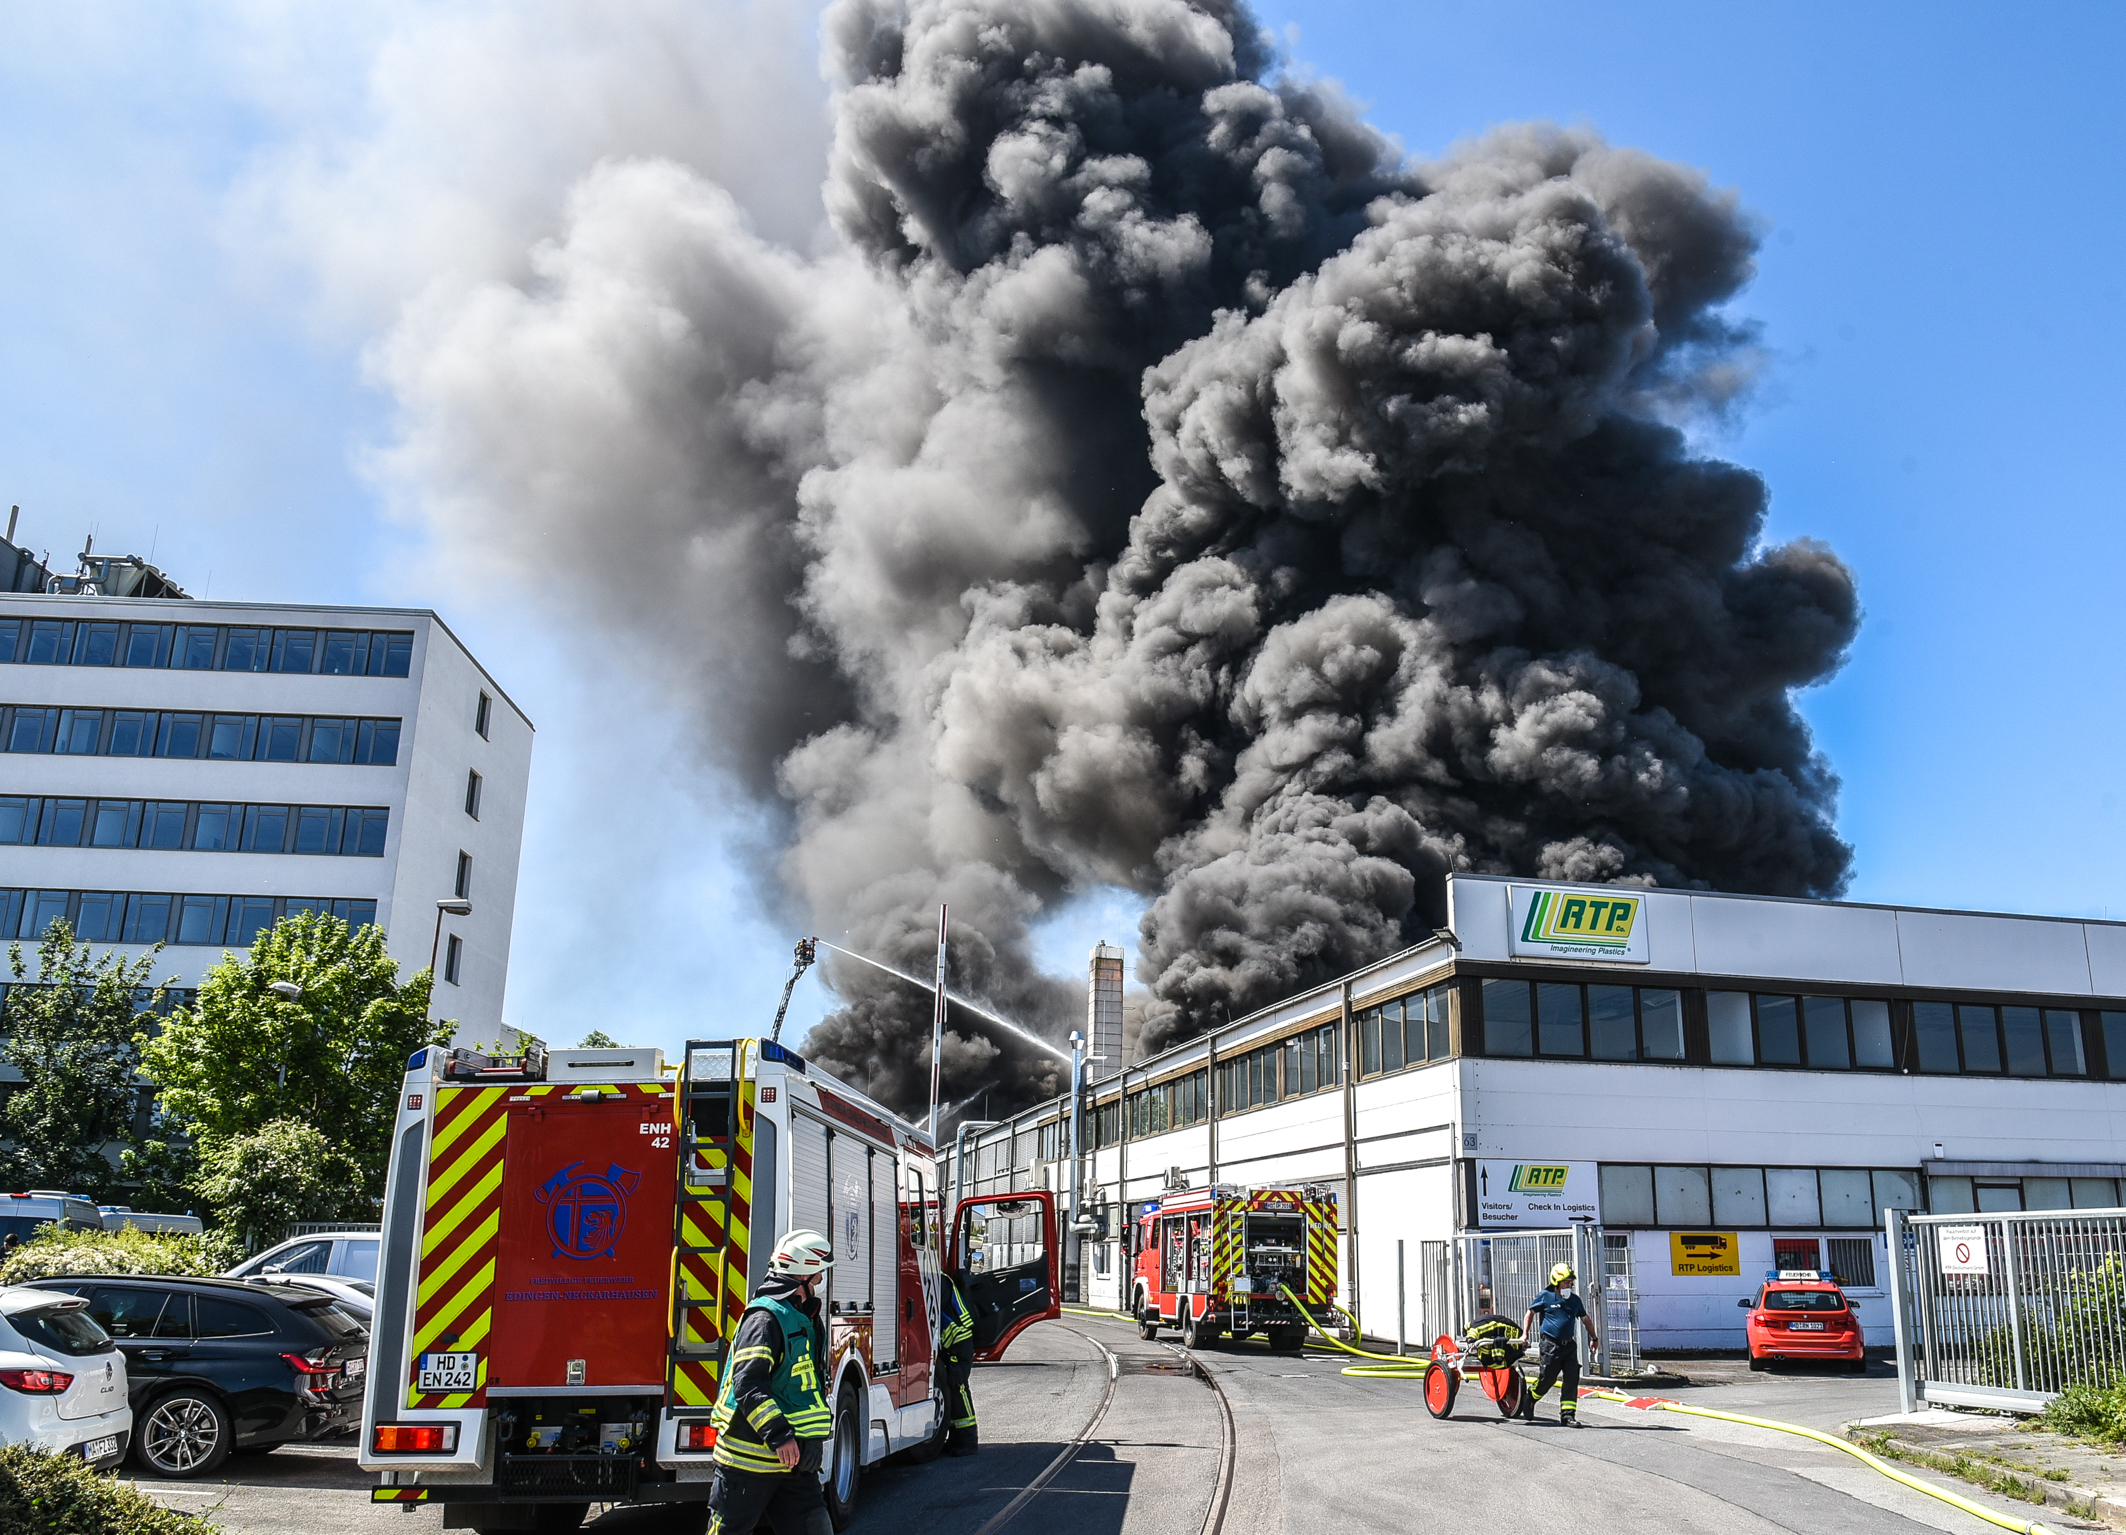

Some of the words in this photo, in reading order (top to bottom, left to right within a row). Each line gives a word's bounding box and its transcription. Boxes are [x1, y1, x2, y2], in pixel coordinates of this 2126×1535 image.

[1560, 899, 1631, 931] RTP
[1550, 945, 1596, 955] Imagineering
[1598, 947, 1625, 955] Plastics
[639, 1123, 671, 1134] ENH
[651, 1137, 670, 1148] 42
[1464, 1136, 1476, 1147] 63
[1528, 1168, 1565, 1184] RTP
[1481, 1202, 1513, 1210] Visitors/
[1528, 1203, 1552, 1211] Check
[1553, 1203, 1561, 1211] In
[1562, 1203, 1596, 1212] Logistics
[1482, 1213, 1518, 1221] Besucher
[1678, 1264, 1695, 1272] RTP
[1697, 1264, 1733, 1273] Logistics
[530, 1277, 582, 1285] FREIWILLIGE
[584, 1276, 634, 1284] FEUERWEHR
[505, 1290, 658, 1301] EDINGEN-NECKARHAUSEN
[437, 1356, 456, 1370] HD
[423, 1372, 442, 1387] EN
[444, 1372, 471, 1387] 242
